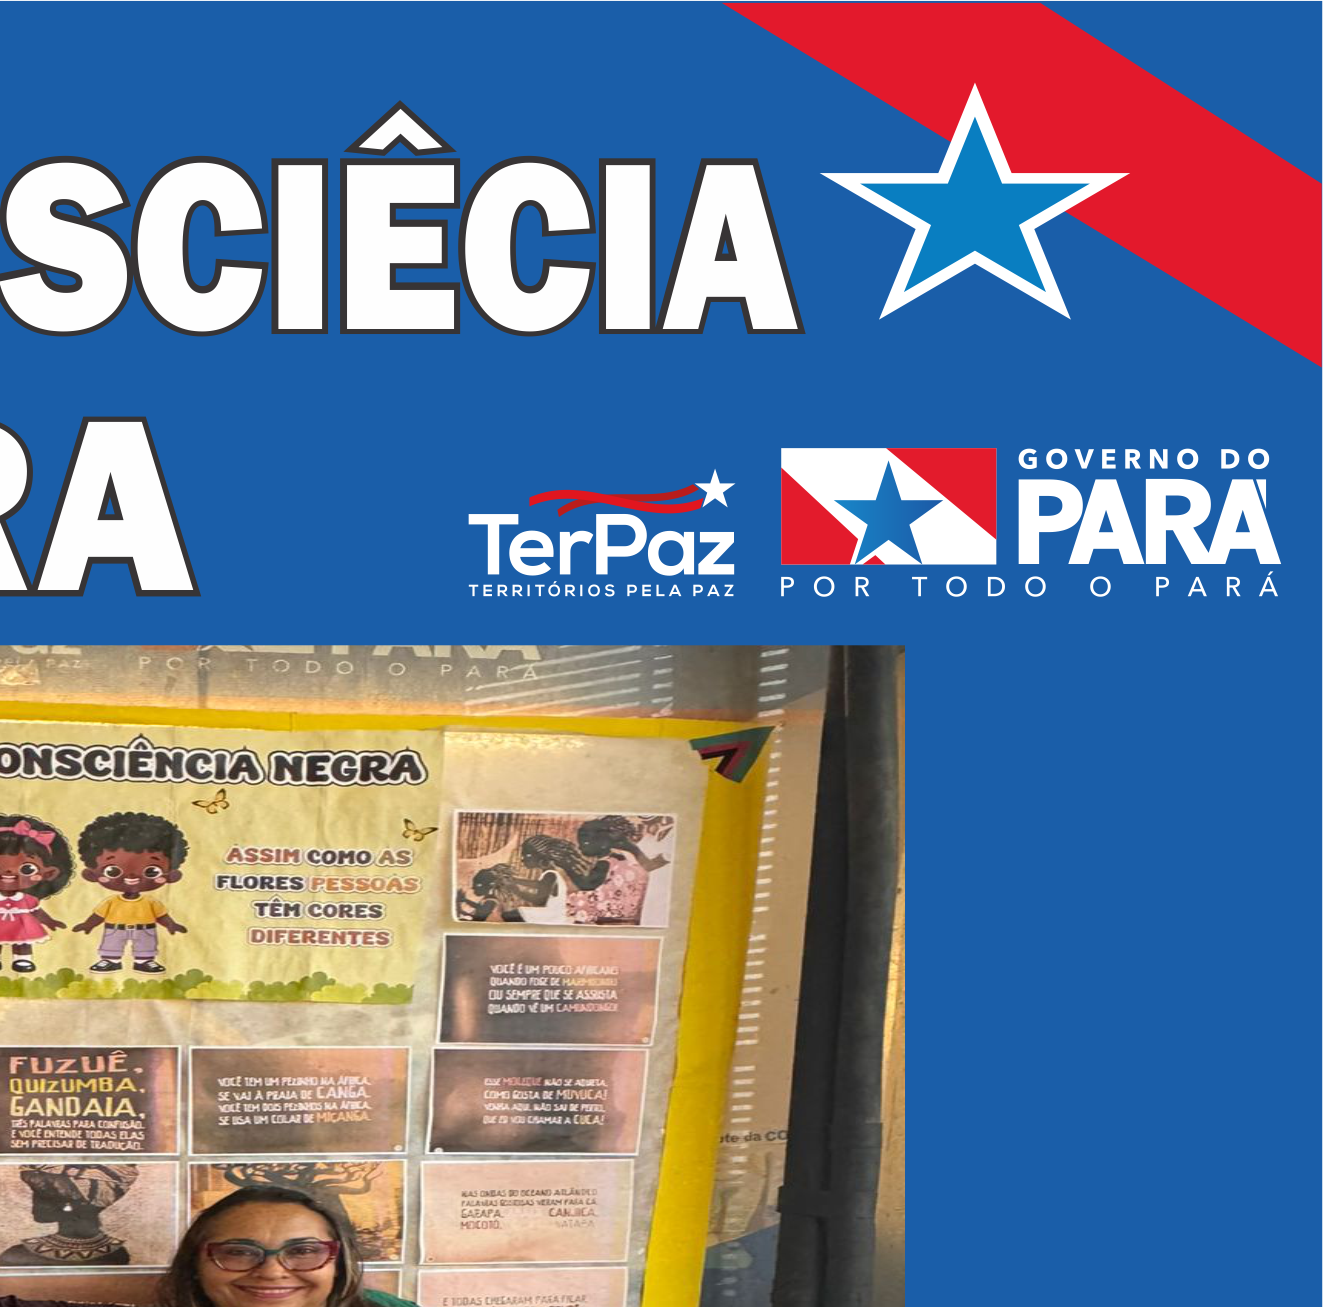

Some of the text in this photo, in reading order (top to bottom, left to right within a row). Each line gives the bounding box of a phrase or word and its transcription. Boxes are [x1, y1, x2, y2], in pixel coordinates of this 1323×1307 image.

[139, 656, 212, 671] POR
[246, 658, 355, 676] TODO
[270, 746, 427, 786] NEGRA
[225, 846, 412, 866] ASSIM COMO AS
[216, 874, 421, 893] FLORES PESSOAS
[254, 897, 383, 919] TÊM CORES
[248, 928, 391, 946] DIFERENTES
